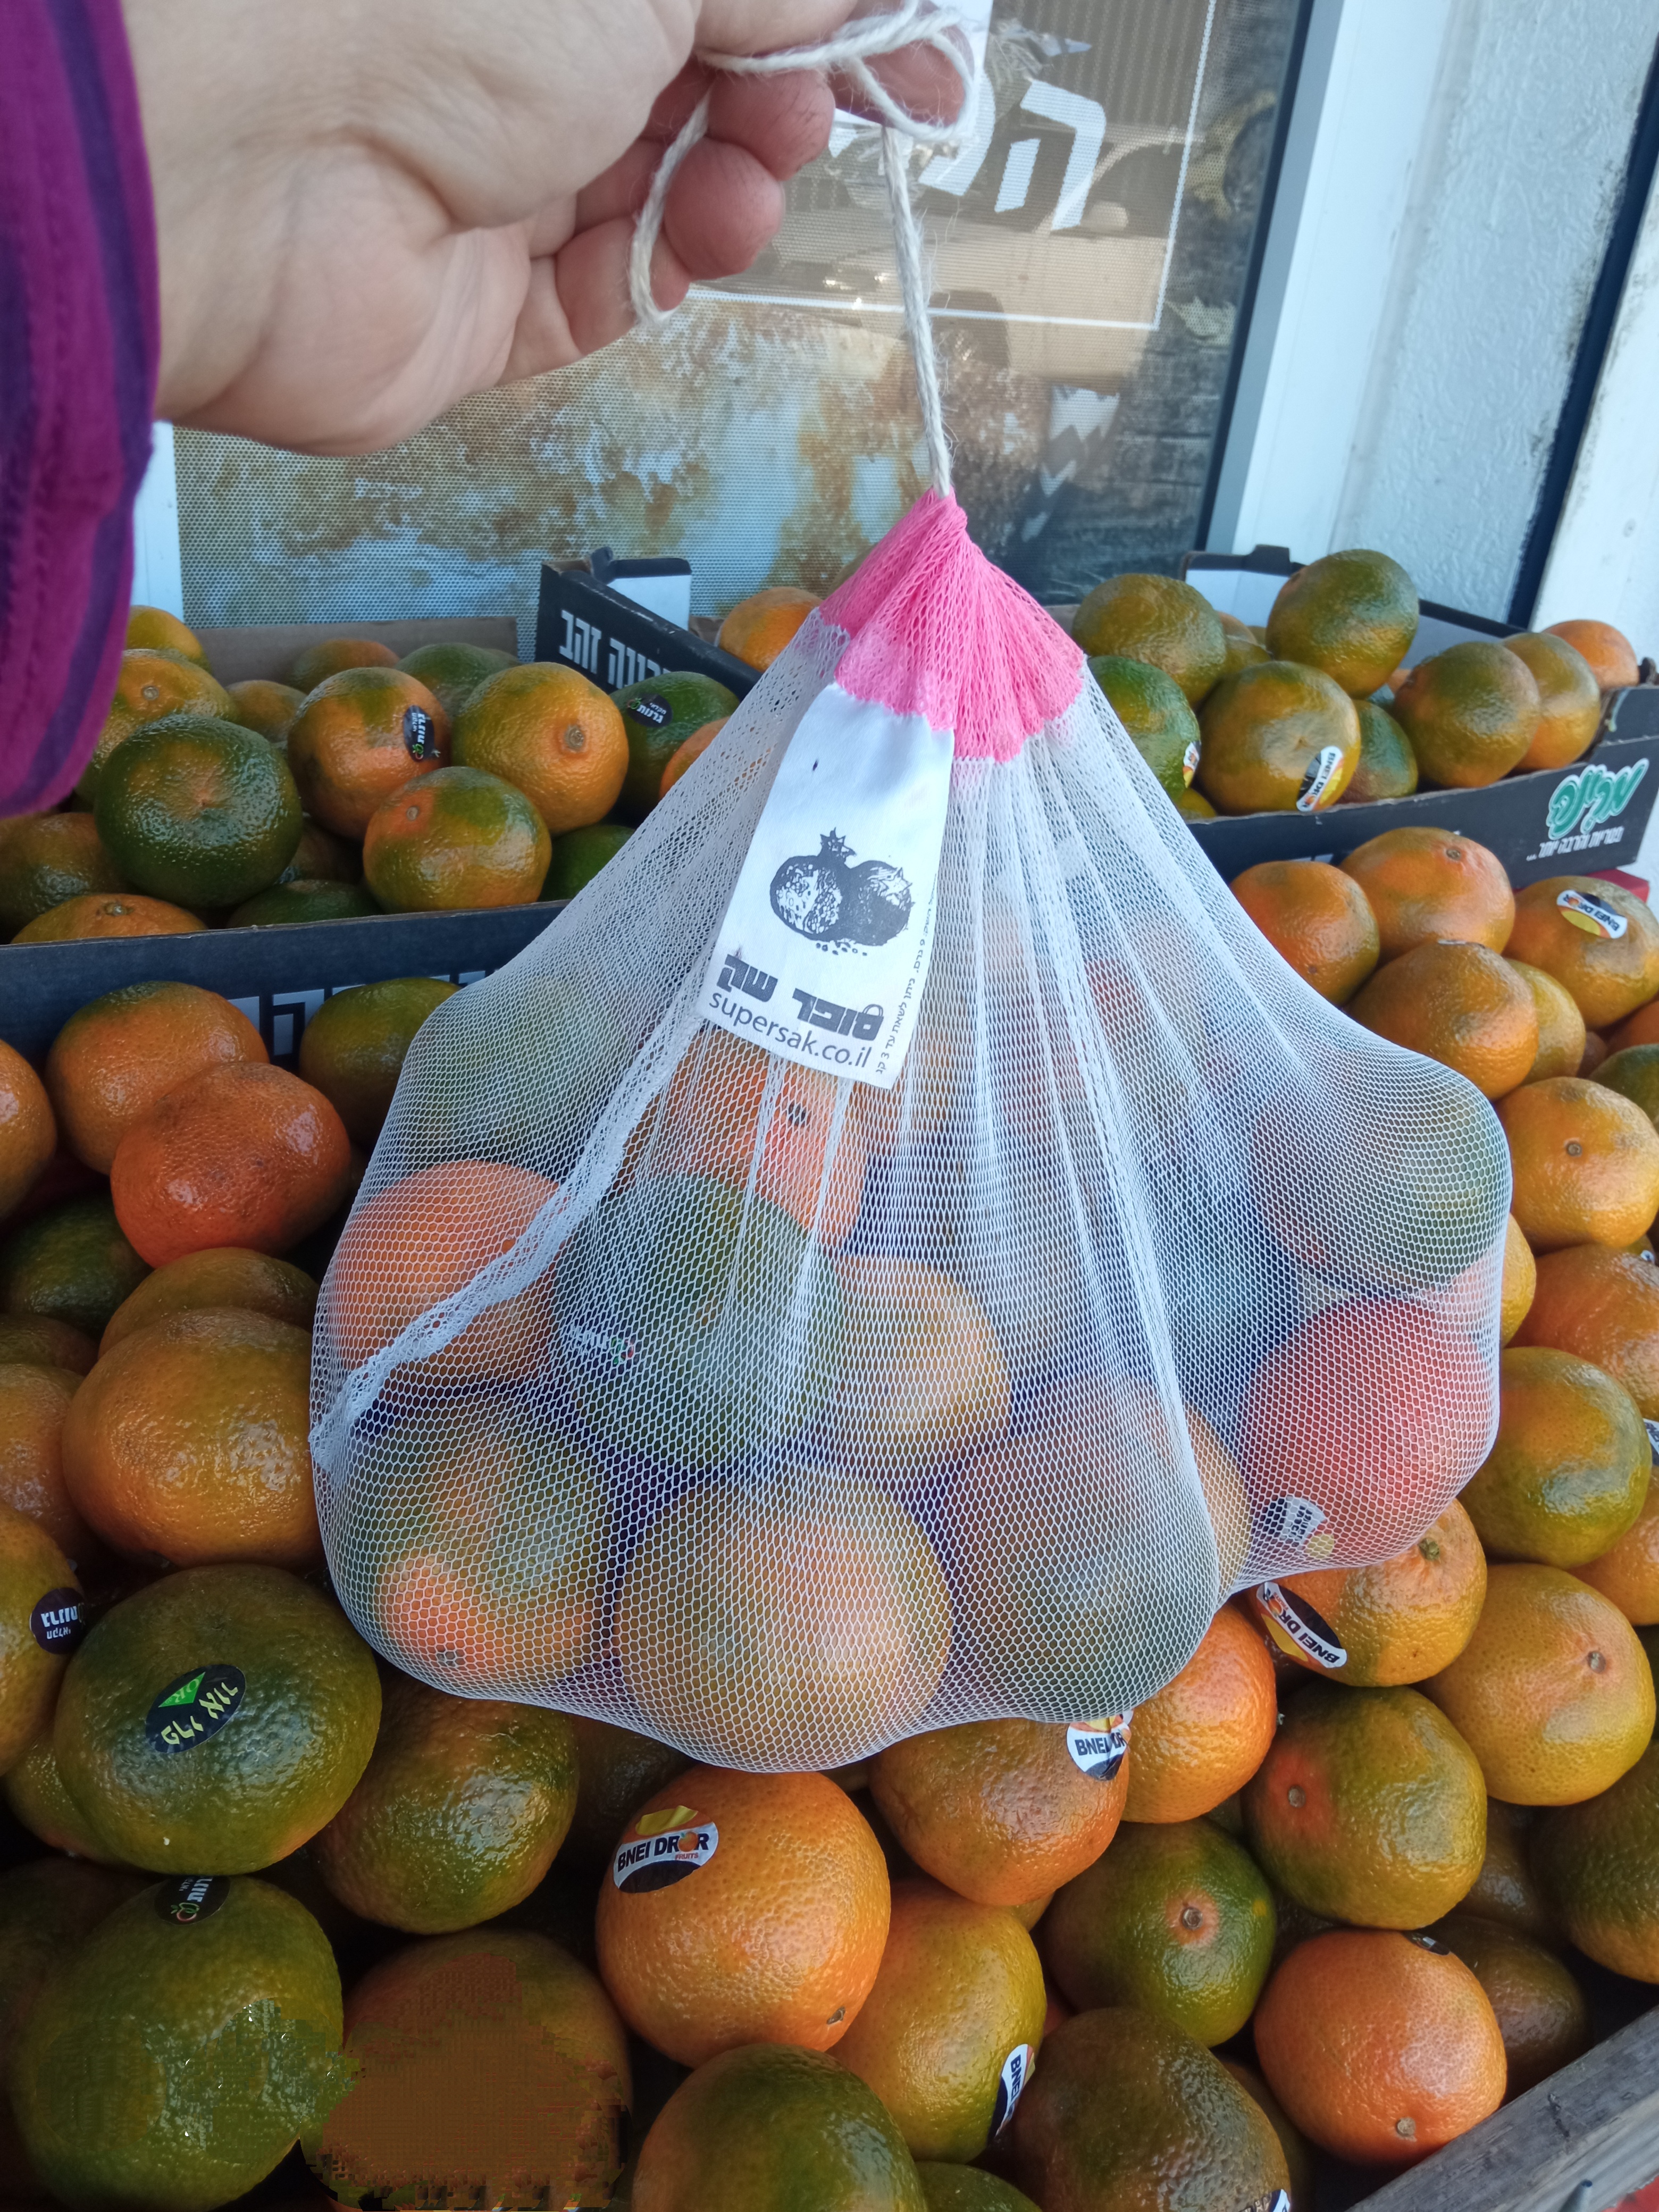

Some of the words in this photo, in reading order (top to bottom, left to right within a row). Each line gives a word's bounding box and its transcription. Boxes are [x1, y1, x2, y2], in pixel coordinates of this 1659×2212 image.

[559, 610, 601, 674] זהב
[636, 705, 664, 724] גרנות
[1594, 910, 1620, 932] BNEI
[717, 954, 778, 1002] שק
[903, 977, 915, 999] ניתן
[792, 987, 884, 1041] סופר
[892, 1001, 907, 1034] לשאת
[709, 992, 872, 1068] supersak.co.il
[885, 1035, 895, 1050] עד
[40, 1606, 78, 1628] גרנות
[47, 1626, 71, 1639] חקלאי
[1298, 1632, 1340, 1663] BNEI
[161, 1715, 205, 1745] פרי
[199, 1682, 239, 1720] אור
[1075, 1737, 1111, 1756] BNEI
[618, 1841, 651, 1873] BNEI
[654, 1833, 710, 1856] DROR
[187, 1878, 213, 1902] רנות
